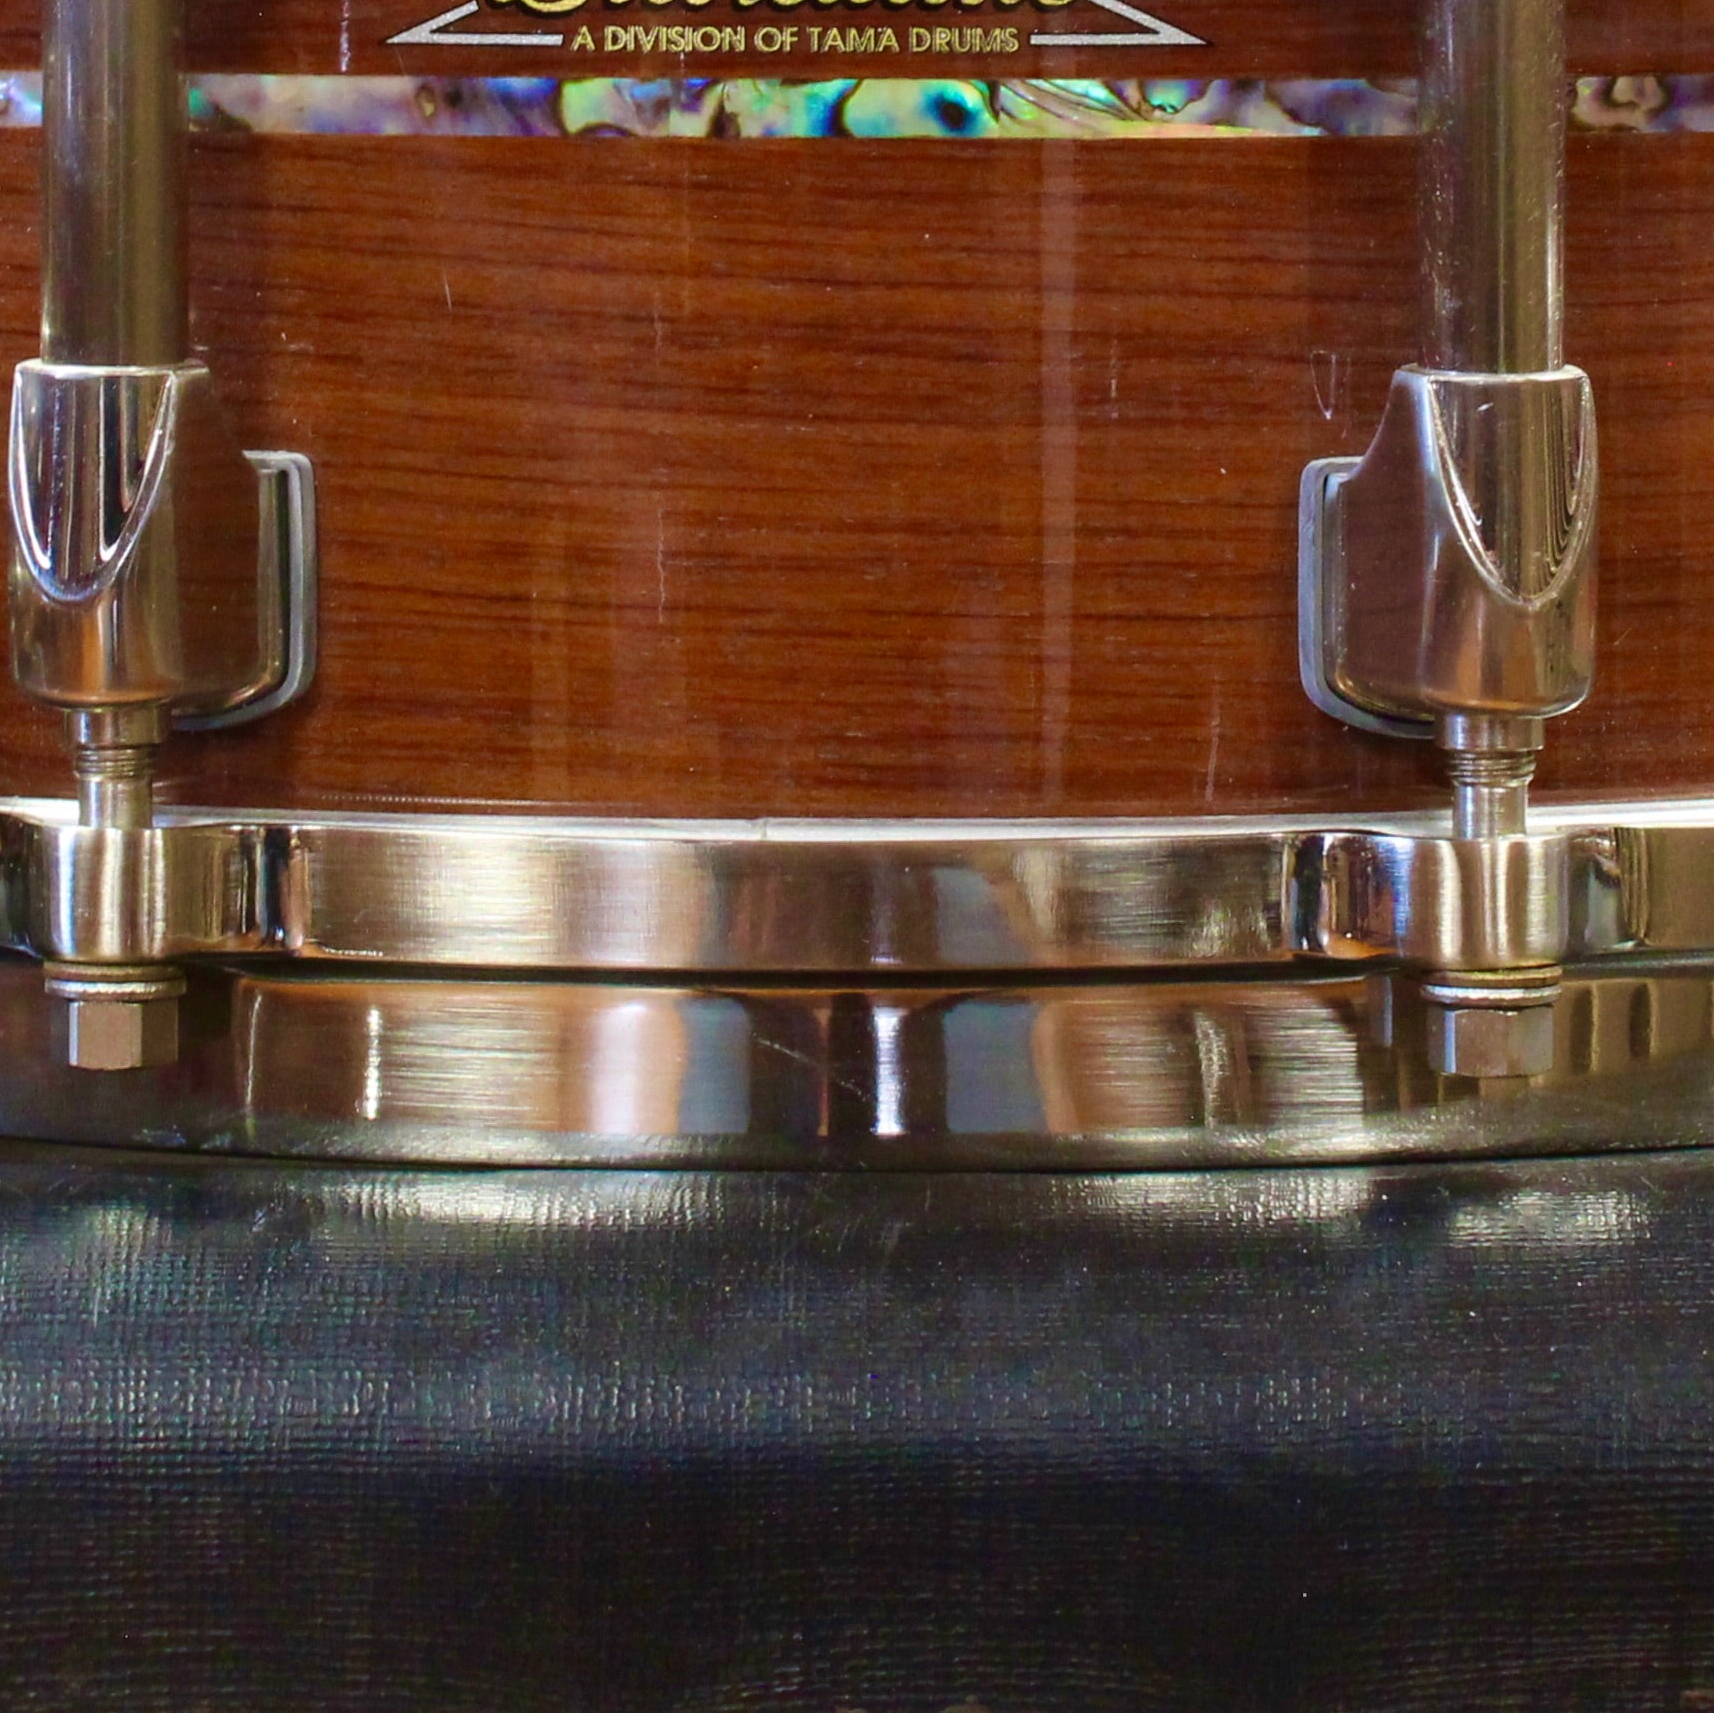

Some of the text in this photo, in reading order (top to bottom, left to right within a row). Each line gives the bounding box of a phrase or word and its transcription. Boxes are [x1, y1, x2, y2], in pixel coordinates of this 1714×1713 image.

[571, 25, 1019, 53] A DIVISION OF TAMA DRUMS
